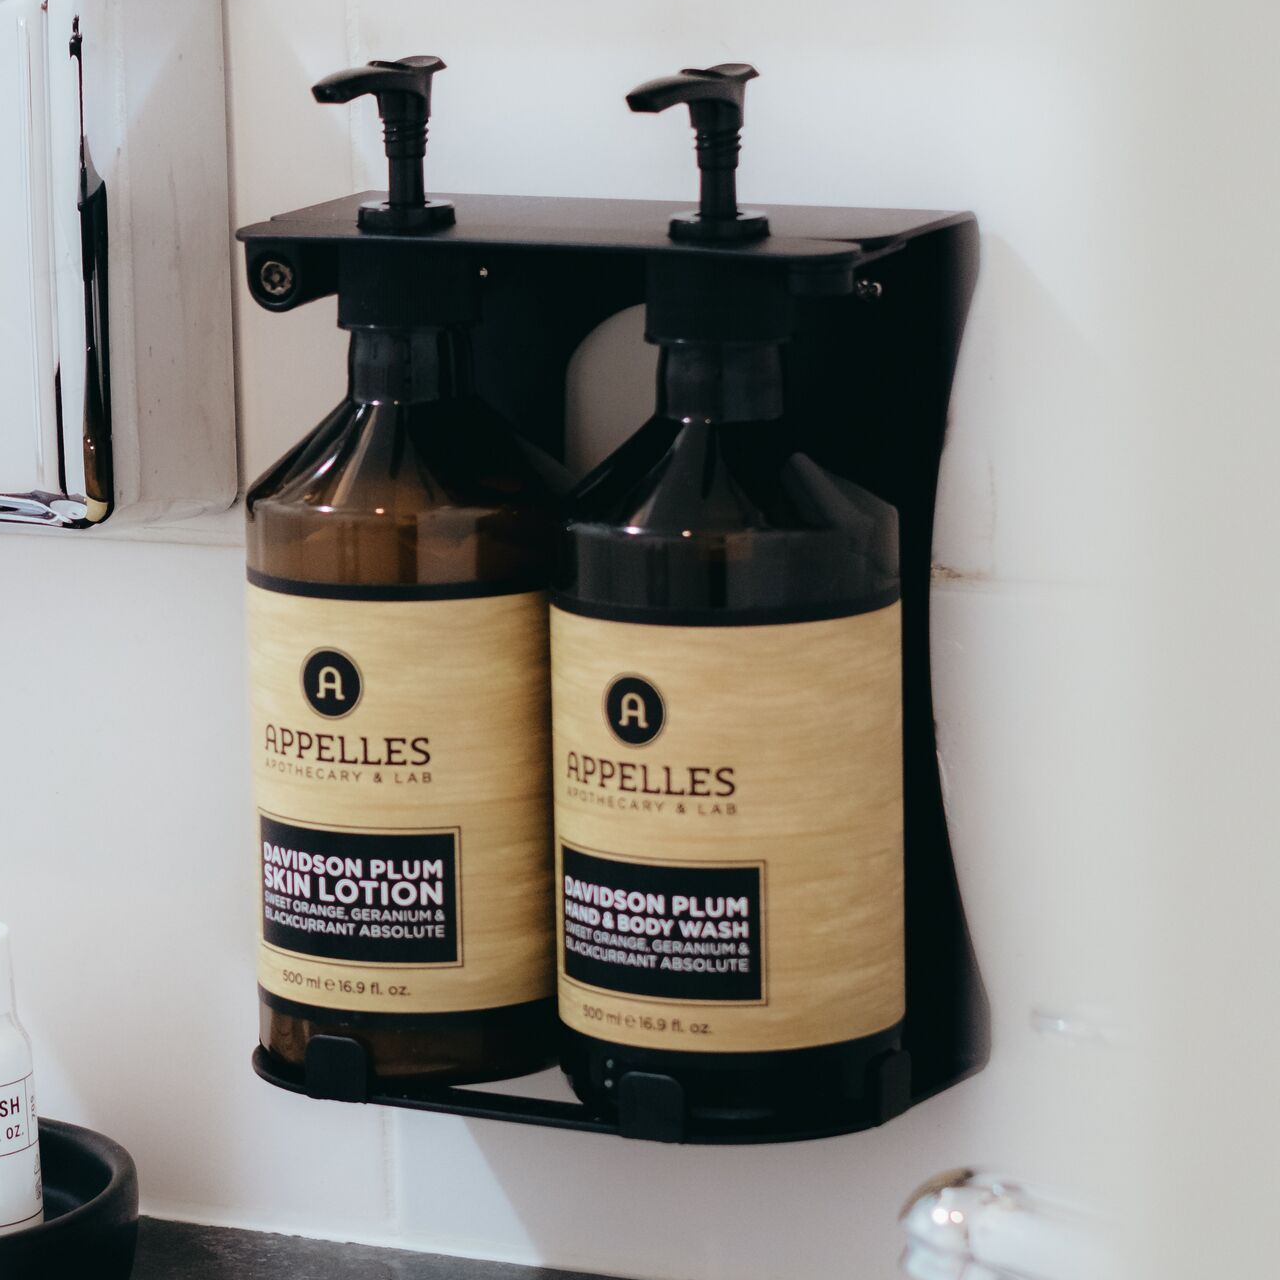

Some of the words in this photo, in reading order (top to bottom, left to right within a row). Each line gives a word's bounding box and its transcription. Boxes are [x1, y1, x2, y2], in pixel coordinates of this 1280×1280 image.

[265, 724, 431, 766] APPELLES
[265, 757, 363, 782] APOTHECARY
[372, 772, 383, 784] &
[394, 772, 432, 784] LAB
[567, 751, 736, 797] APPELLES
[567, 786, 665, 811] APOTHECARY
[676, 803, 686, 815] &
[697, 803, 738, 816] LAB
[263, 841, 363, 879] DAVIDSON
[370, 859, 443, 880] PLUM
[264, 863, 311, 899] SKIN
[319, 876, 443, 906] LOTION
[564, 874, 666, 916] DAVIDSON
[671, 895, 748, 918] PLUM
[264, 889, 293, 910] SWEET
[293, 900, 349, 921] ORANGE,
[351, 907, 432, 922] GERANIUM
[434, 908, 445, 922] &
[265, 906, 355, 936] BLACKCURRANT
[359, 924, 445, 939] ABSOLUTE
[565, 898, 601, 926] HAND
[602, 911, 615, 930] &
[617, 913, 675, 937] BODY
[678, 920, 749, 939] WASH
[565, 919, 593, 940] SWEET
[652, 939, 736, 956] GERANIUM
[738, 941, 750, 956] &
[565, 935, 658, 969] BLACKCURRANT
[660, 956, 749, 973] ABSOLUTE
[283, 969, 303, 985] 500
[306, 976, 320, 989] ml
[338, 979, 365, 994] 16.9
[370, 982, 383, 995] fl.
[388, 984, 411, 996] oz.
[583, 1004, 603, 1021] 500
[639, 1016, 667, 1032] 16.9
[6, 1124, 24, 1140] OZ.
